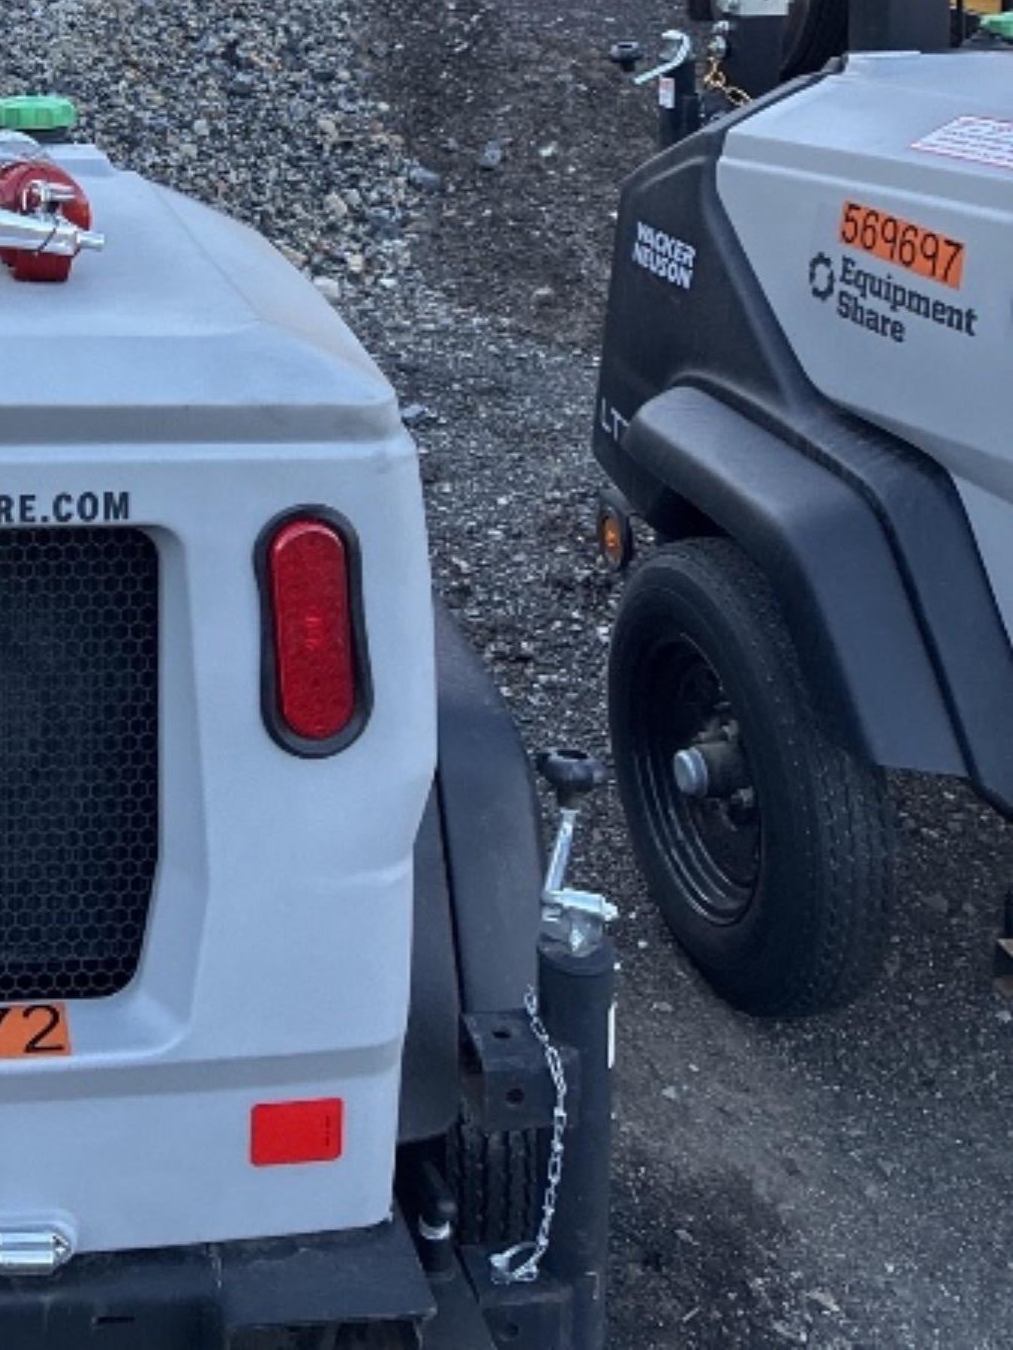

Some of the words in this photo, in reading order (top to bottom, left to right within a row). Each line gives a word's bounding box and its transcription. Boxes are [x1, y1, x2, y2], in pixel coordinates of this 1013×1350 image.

[633, 244, 694, 289] NEUSON
[636, 221, 696, 267] WACKER
[841, 202, 964, 283] 569697
[836, 292, 907, 344] Share
[838, 255, 978, 337] Equipment
